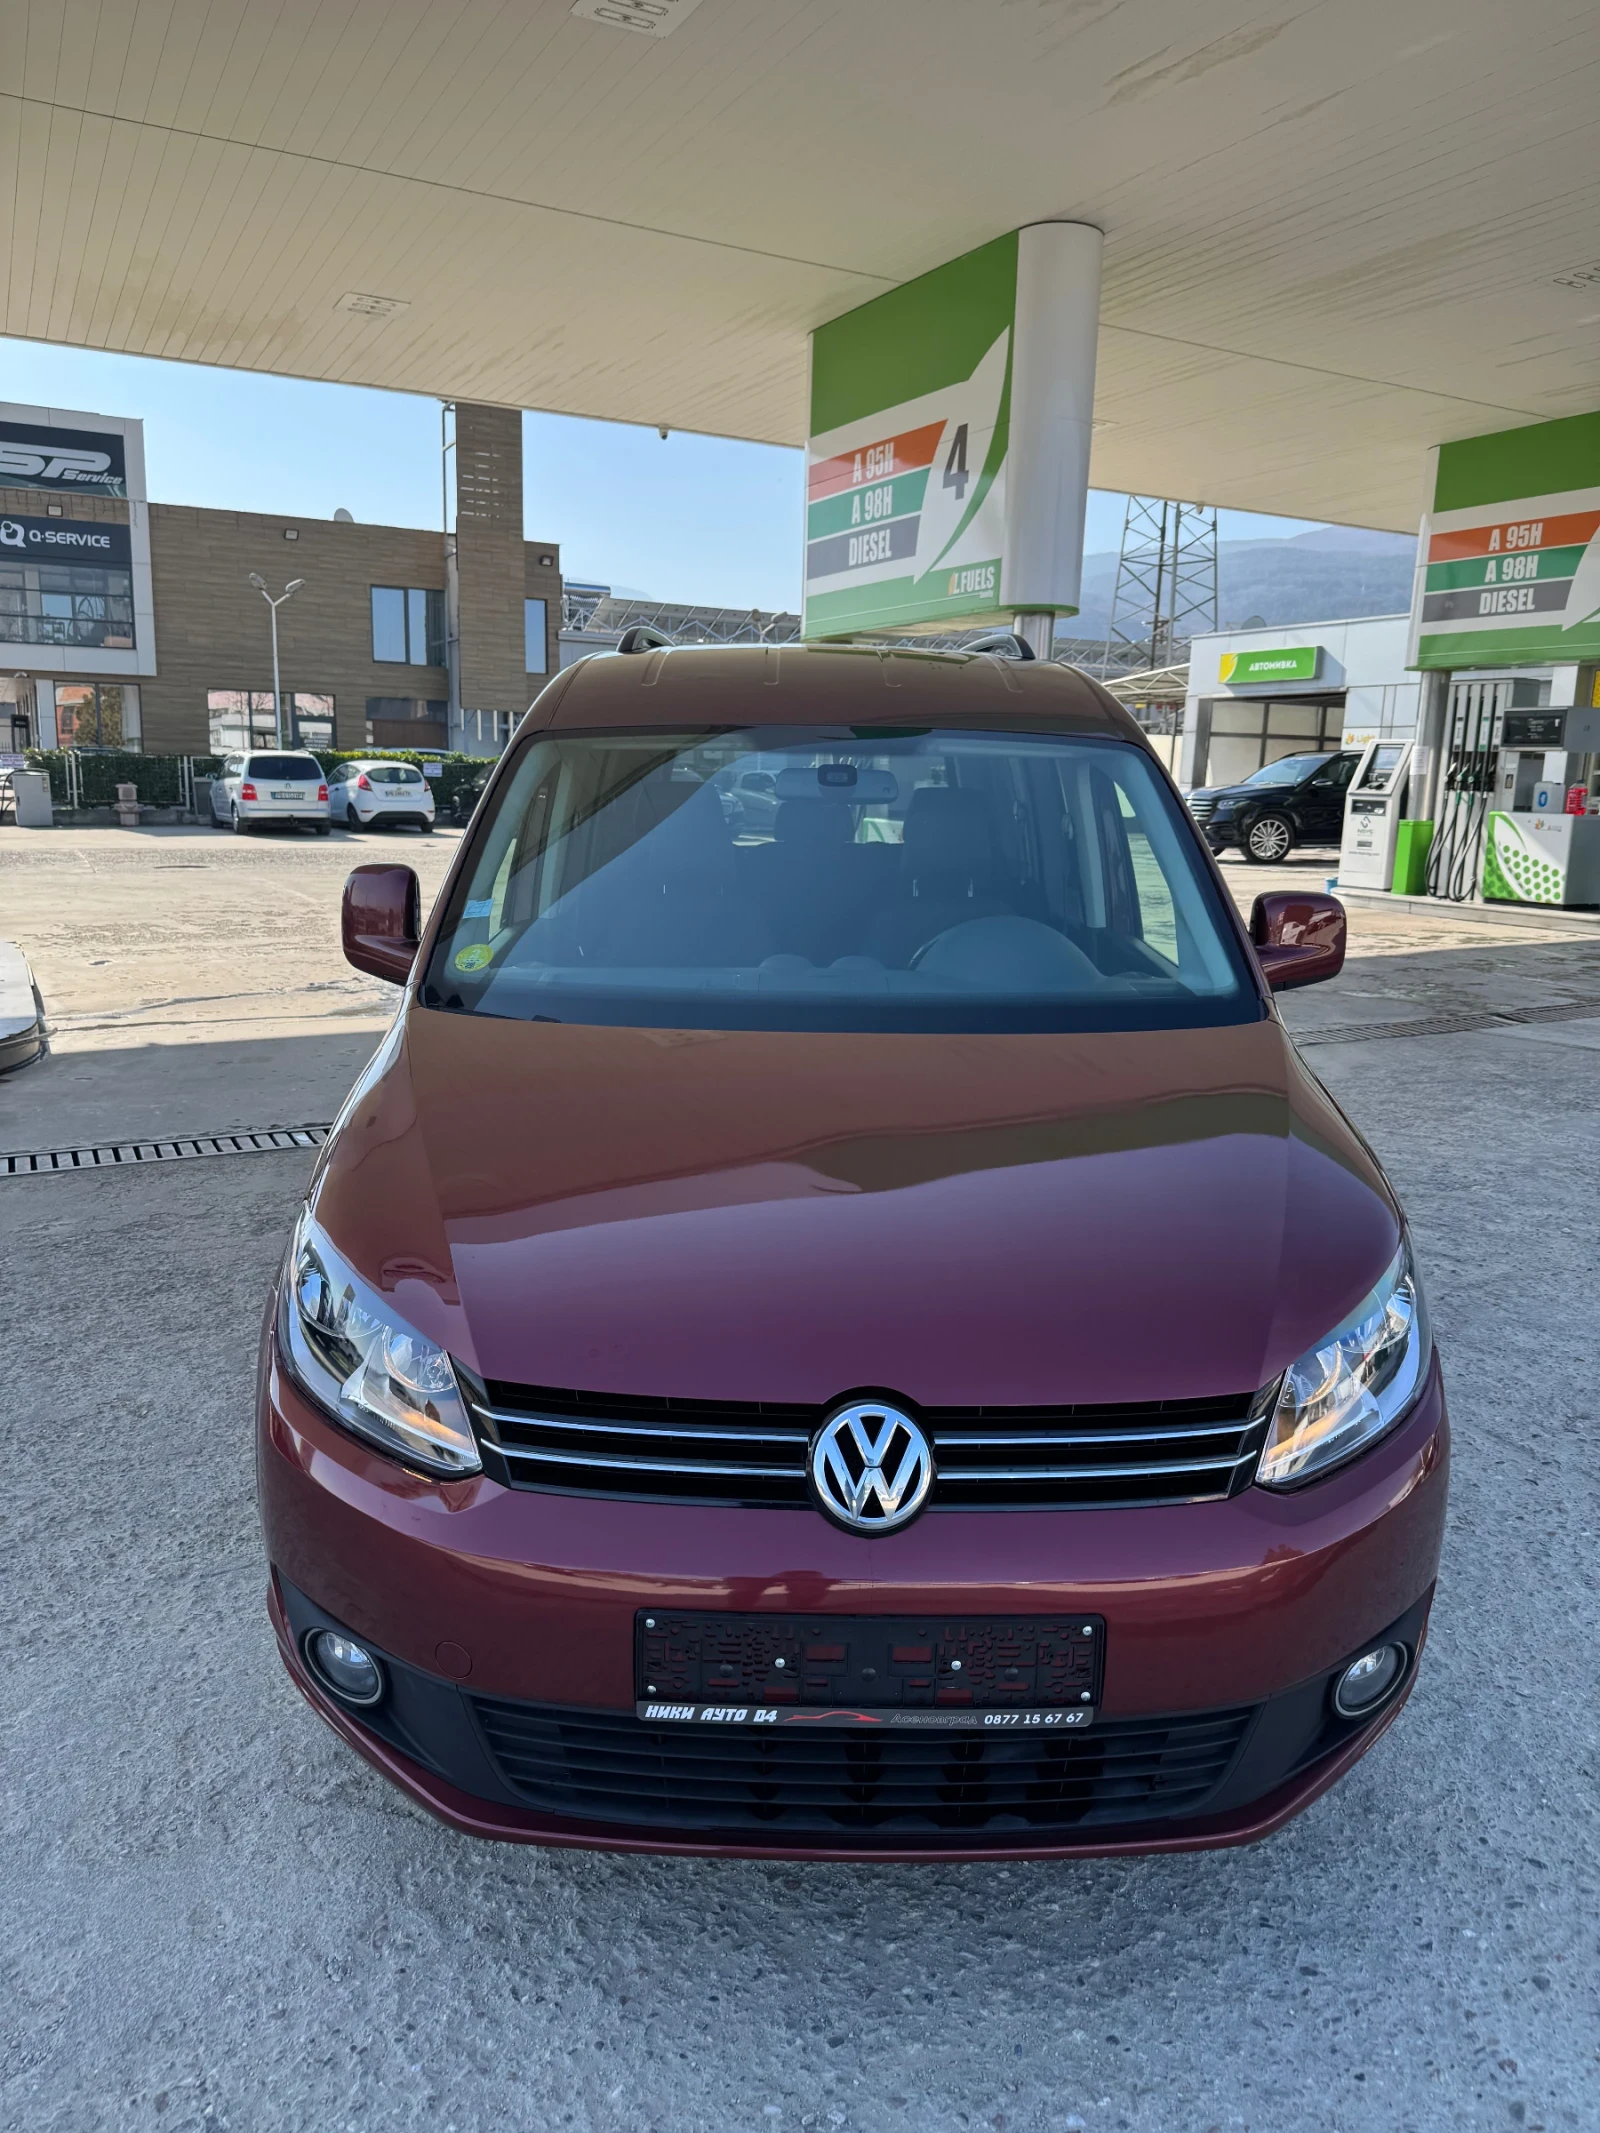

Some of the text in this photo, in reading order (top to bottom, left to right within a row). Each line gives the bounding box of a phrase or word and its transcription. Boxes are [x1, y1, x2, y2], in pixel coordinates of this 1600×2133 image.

[852, 441, 894, 483] A 95H
[942, 423, 970, 501] 4
[61, 470, 124, 485] Service
[851, 485, 893, 524] A 98H
[848, 528, 893, 567] DIESEL
[1487, 522, 1544, 552] A 95H
[1484, 554, 1540, 583] A 98H
[1478, 587, 1536, 615] DIESEL
[1248, 660, 1298, 672] АВТОМИВКА
[645, 1705, 696, 1720] НИКИ
[700, 1708, 749, 1722] АУТО
[984, 1712, 1084, 1725] 0877 15 67 67
